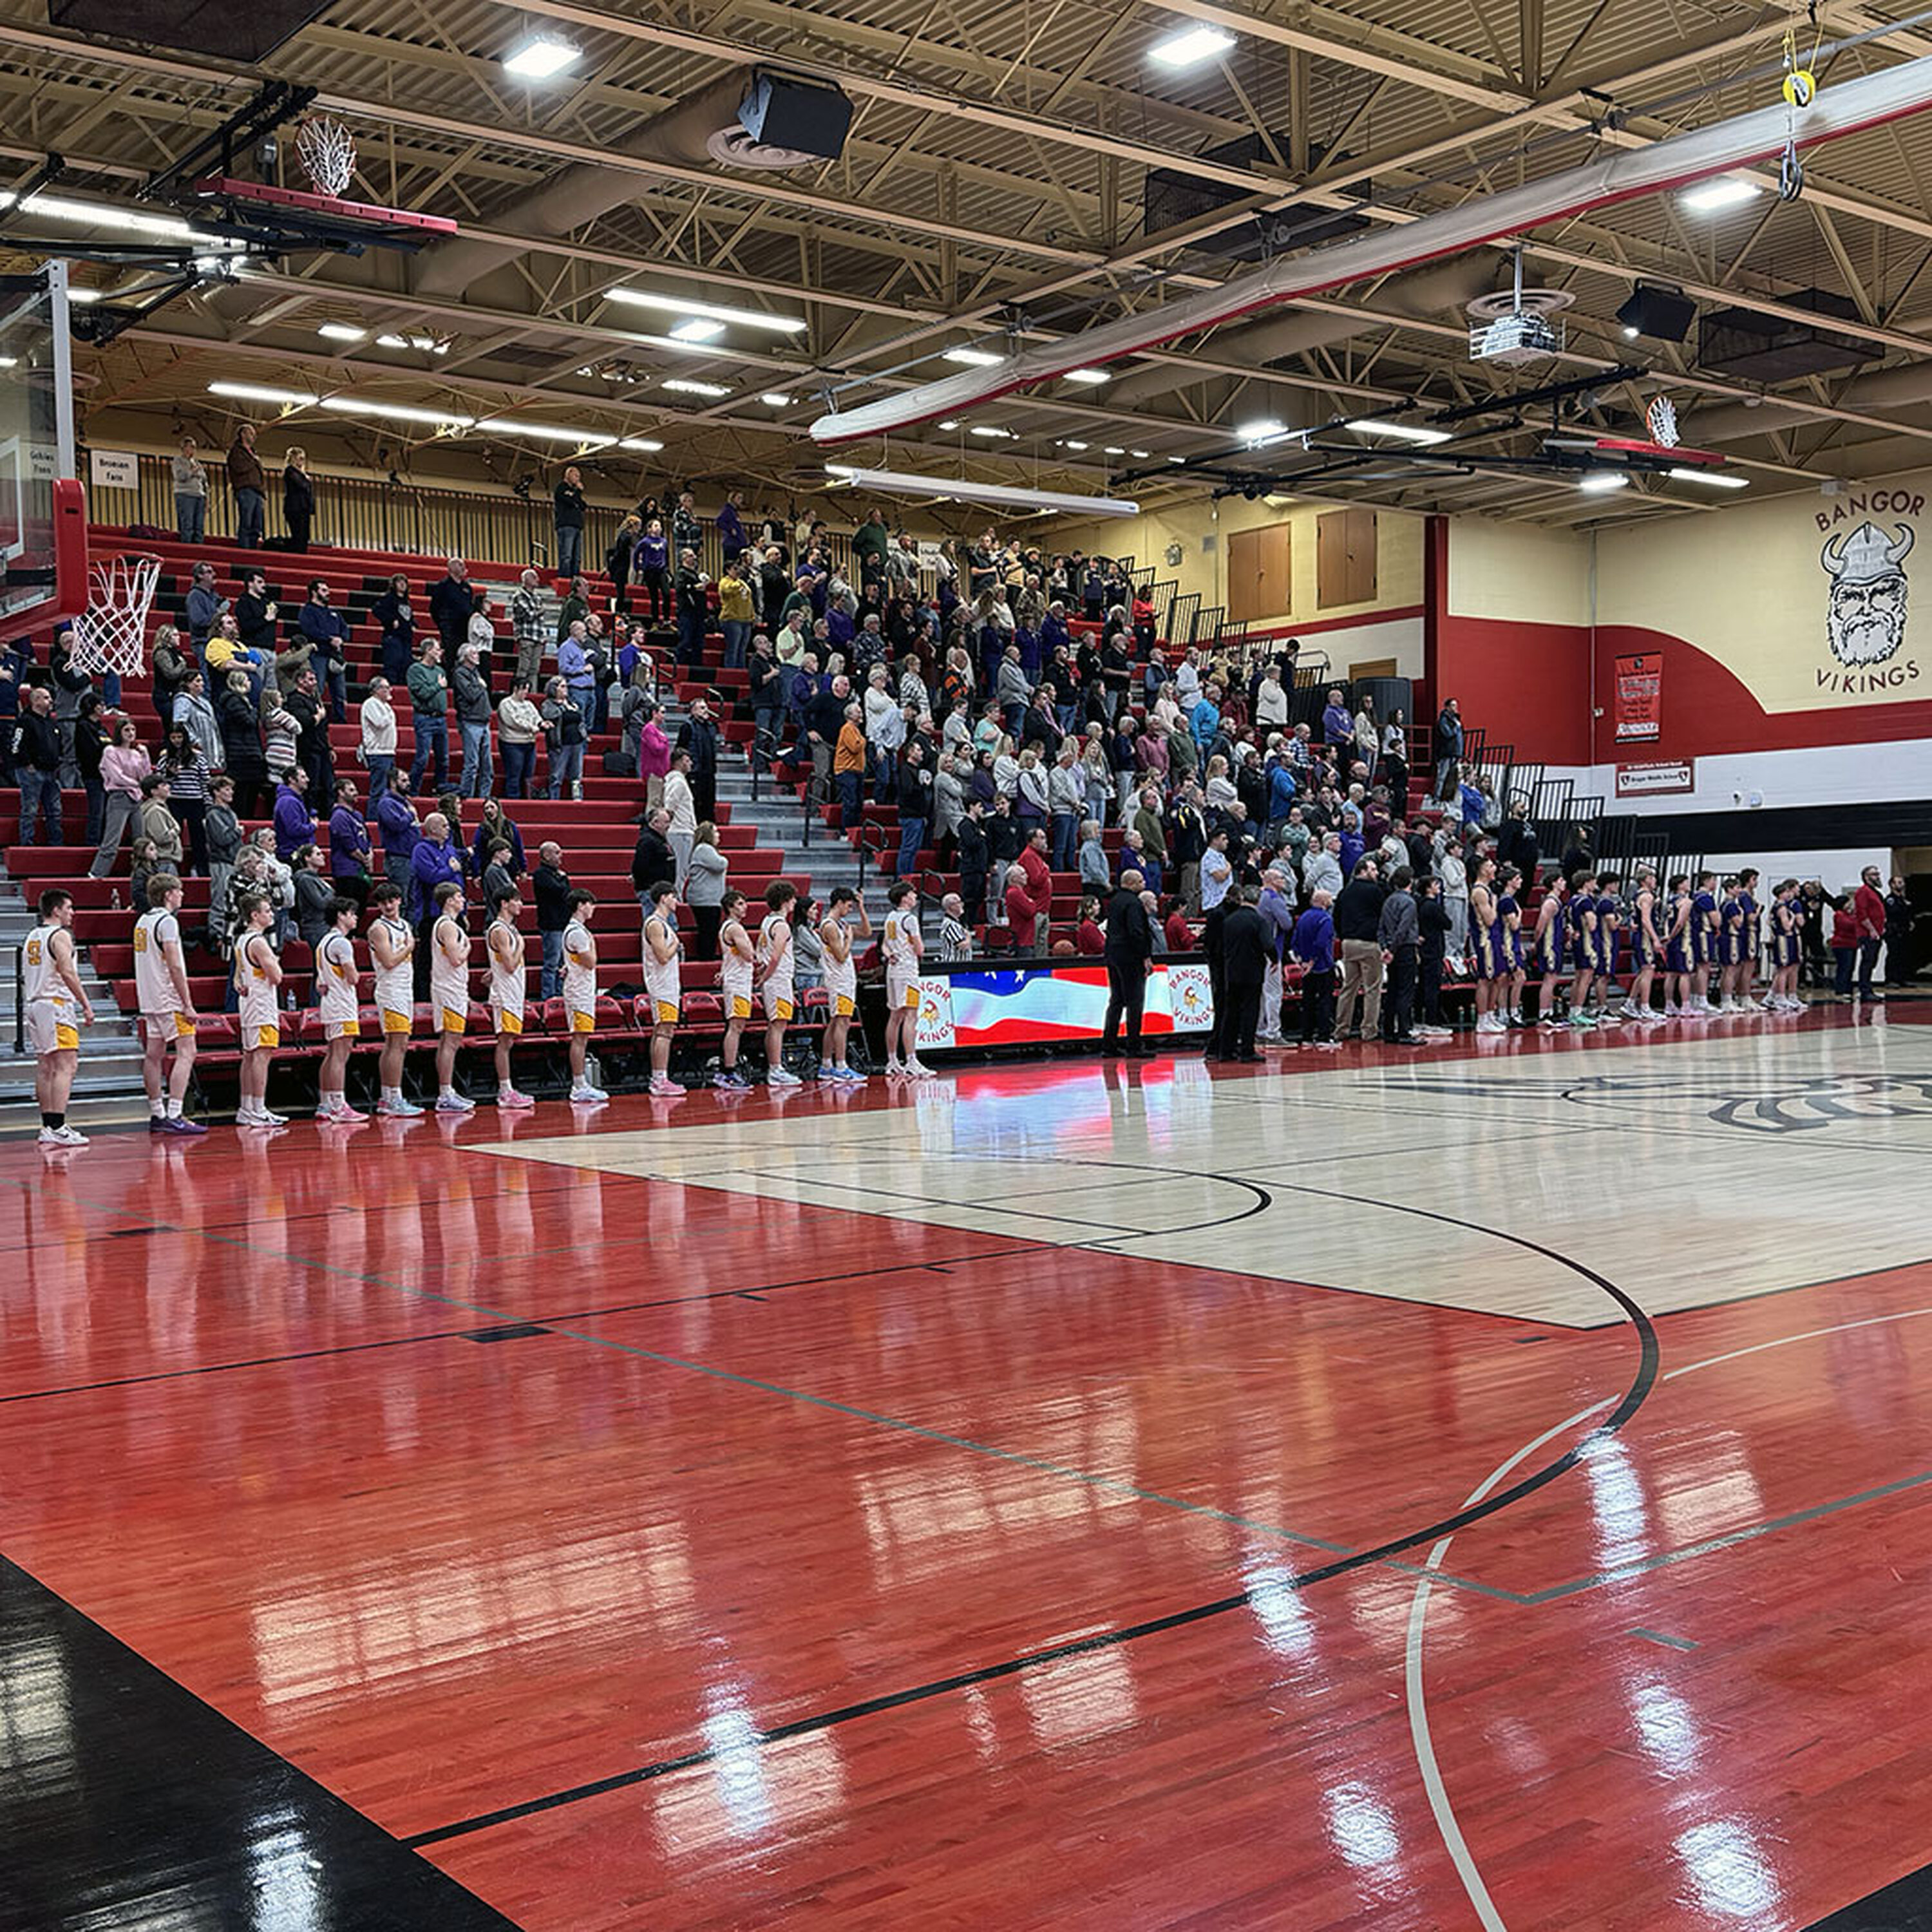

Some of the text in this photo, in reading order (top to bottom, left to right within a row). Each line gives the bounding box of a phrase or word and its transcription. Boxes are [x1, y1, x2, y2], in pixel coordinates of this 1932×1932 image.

[1815, 491, 1925, 532] BANGOR
[1817, 660, 1920, 693] VIKINGS
[1170, 969, 1211, 989] BANGOR
[1174, 1005, 1214, 1025] VIKINGS
[918, 1020, 955, 1042] KINGS
